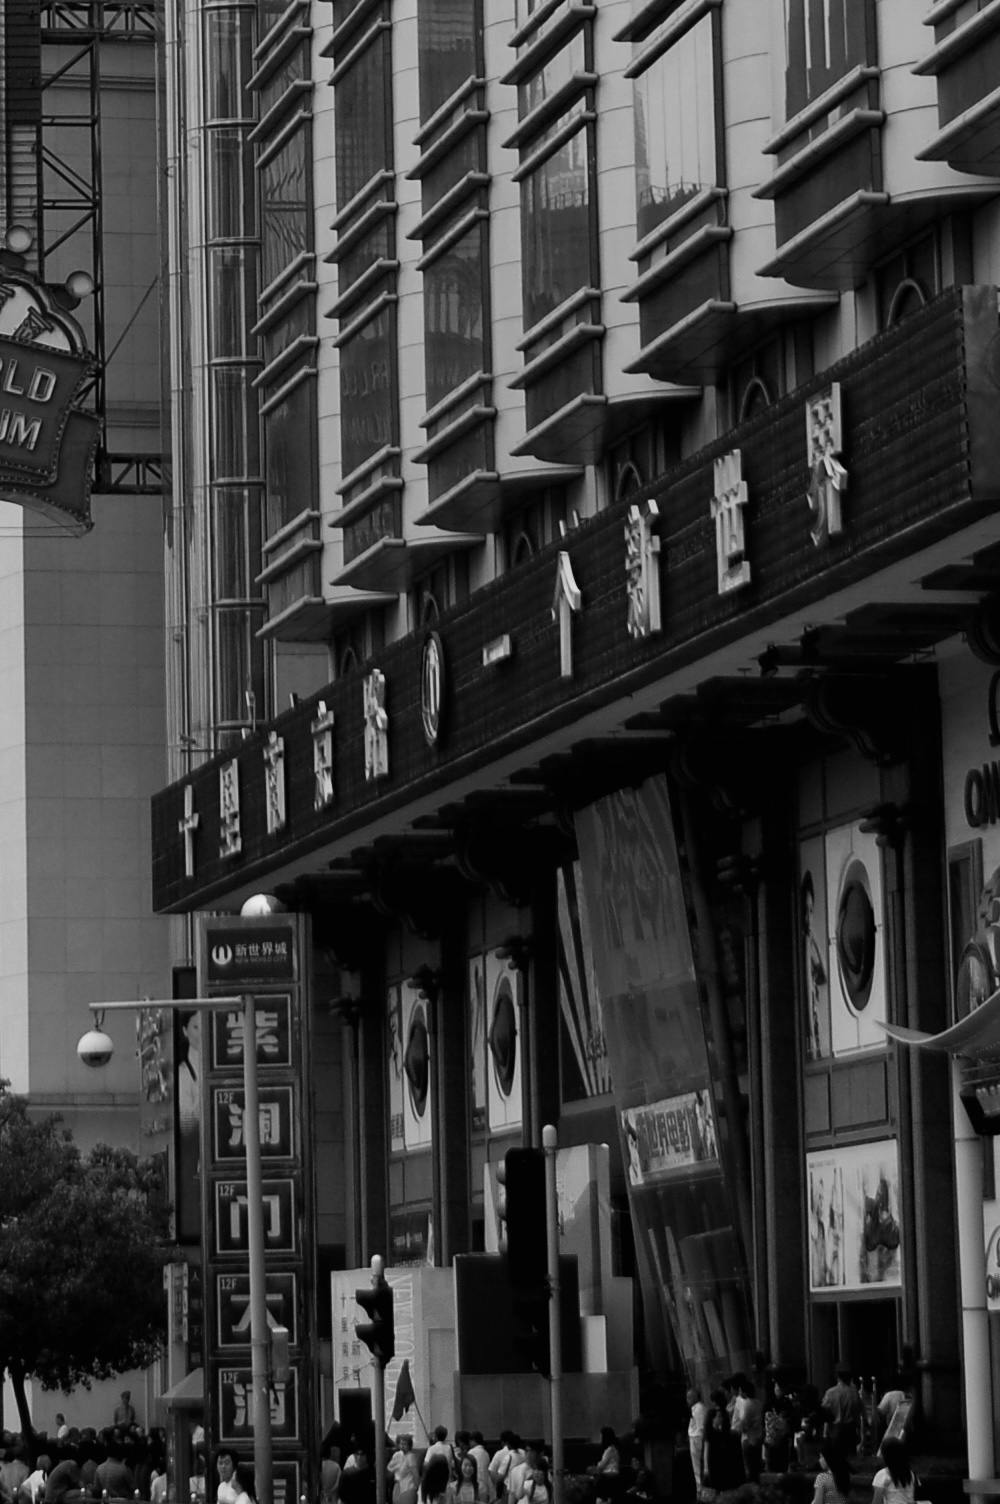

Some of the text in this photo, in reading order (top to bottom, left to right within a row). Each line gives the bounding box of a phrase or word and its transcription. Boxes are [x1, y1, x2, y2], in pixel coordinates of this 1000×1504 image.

[218, 1091, 235, 1104] 12F
[219, 1184, 236, 1197] 12F
[220, 1277, 237, 1290] 12F
[222, 1371, 239, 1384] 12F
